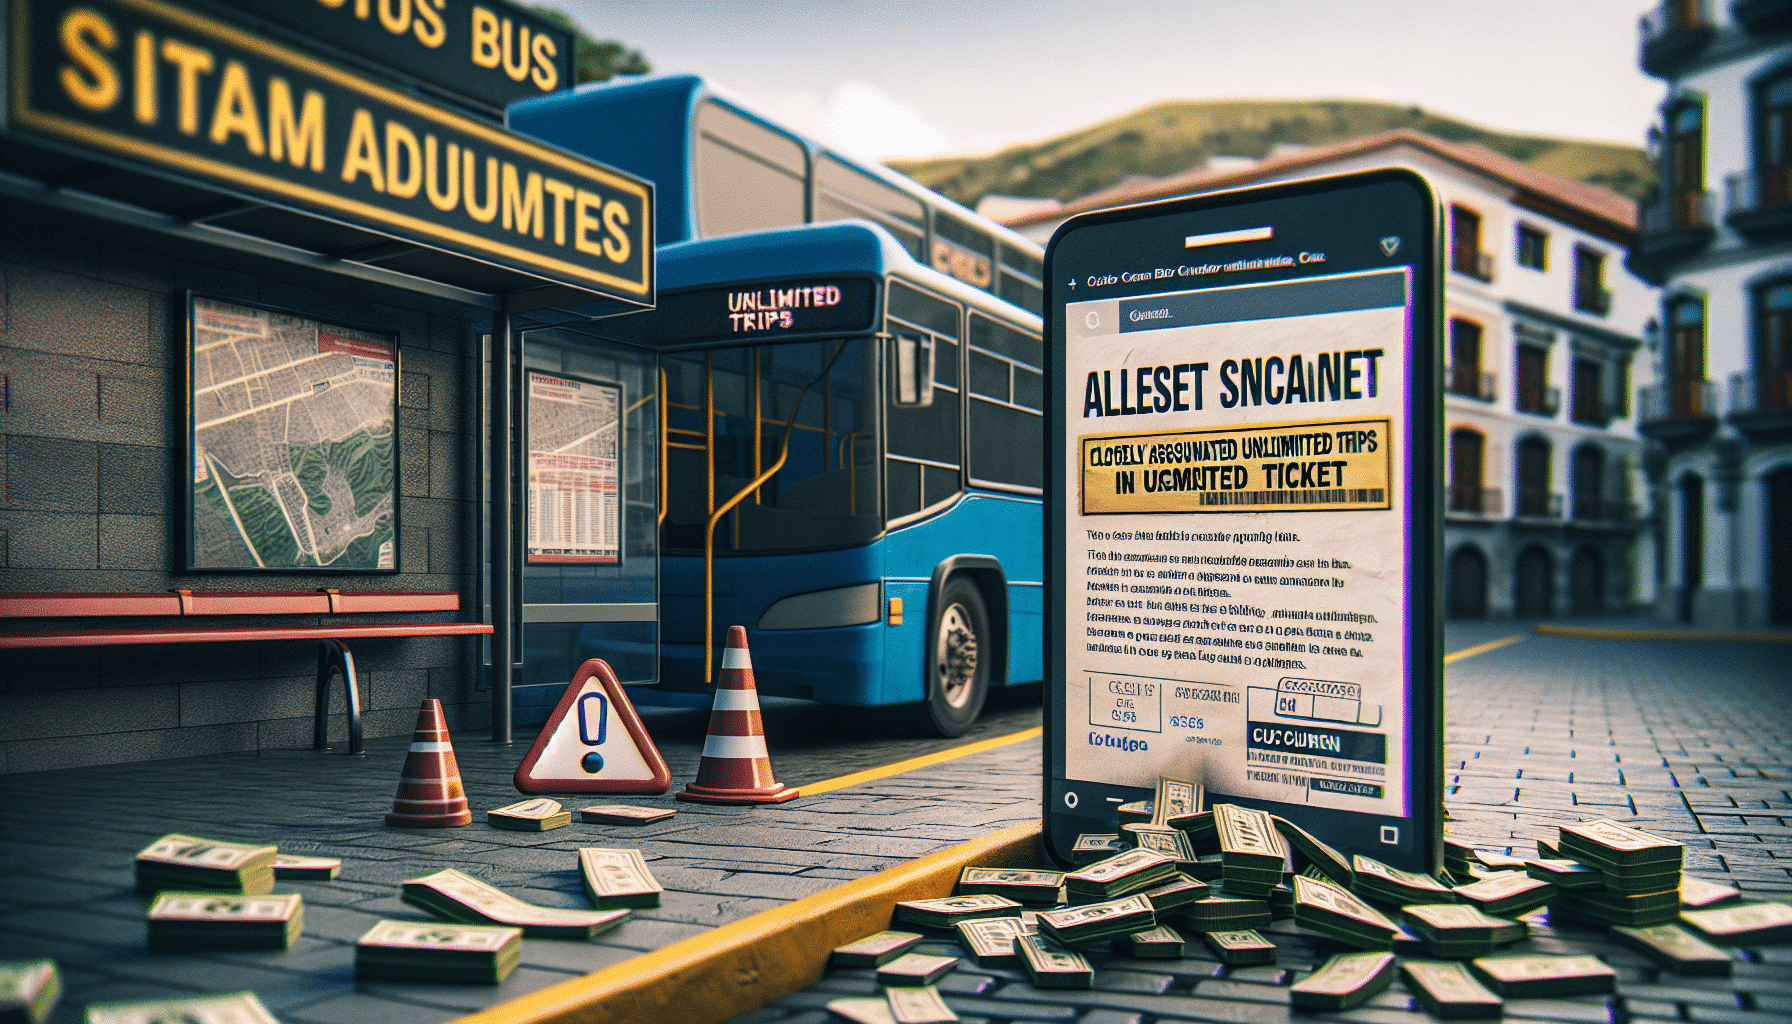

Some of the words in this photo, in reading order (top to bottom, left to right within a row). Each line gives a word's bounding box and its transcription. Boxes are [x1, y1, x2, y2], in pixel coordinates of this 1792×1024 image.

[472, 6, 558, 92] BUS
[59, 9, 326, 173] SITAM
[340, 108, 633, 265] ADUUMTES
[728, 285, 841, 312] UNLIMITED
[1083, 362, 1208, 418] ALLESET
[1116, 471, 1135, 494] IN
[1261, 461, 1348, 489] TICKET
